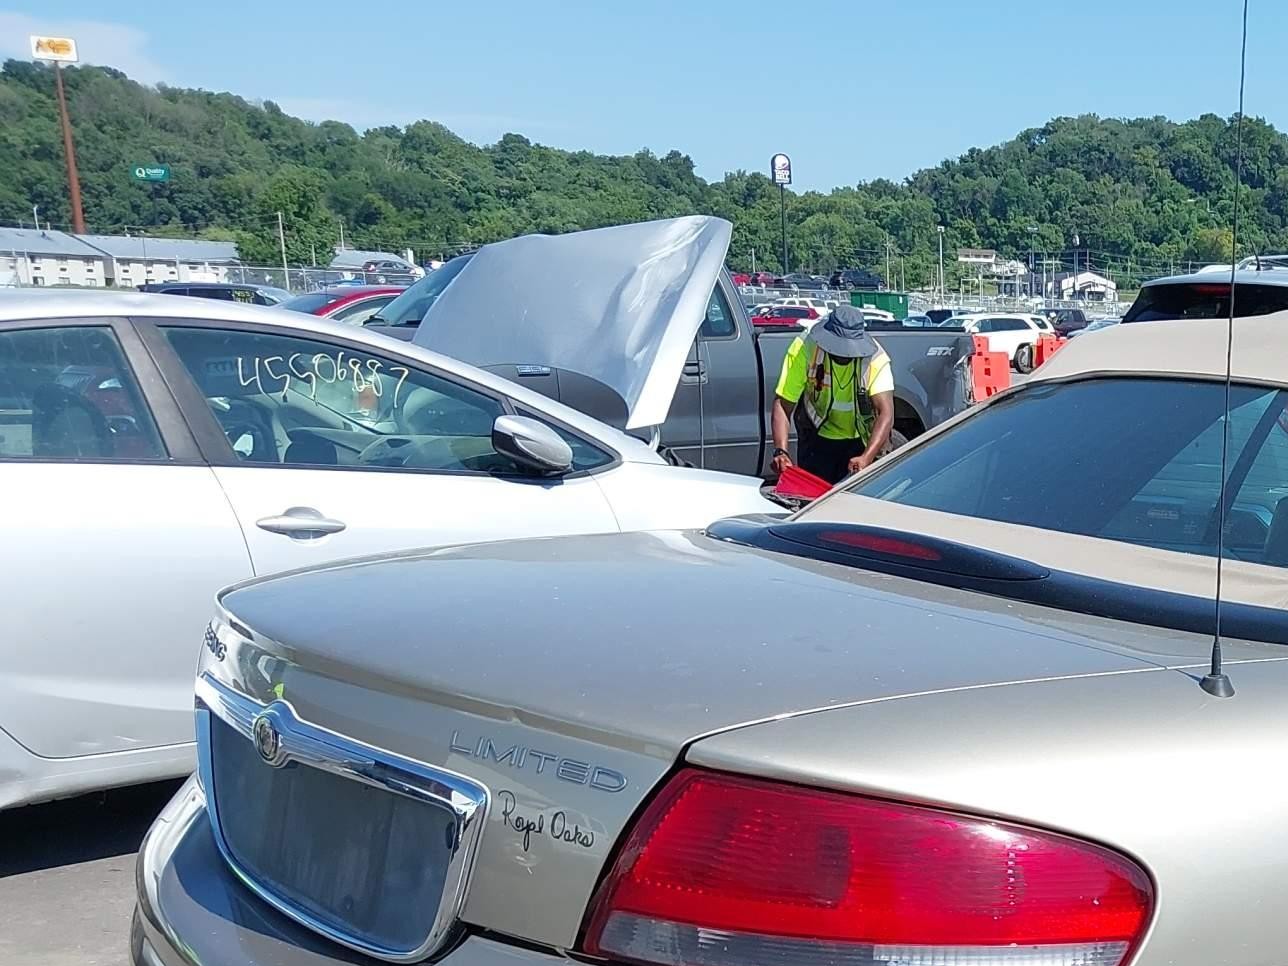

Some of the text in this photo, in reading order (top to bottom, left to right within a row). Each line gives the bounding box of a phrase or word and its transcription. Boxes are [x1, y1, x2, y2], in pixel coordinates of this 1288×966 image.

[926, 346, 956, 356] STX
[449, 730, 627, 793] LIMITED
[498, 790, 594, 851] Royal Oaks
